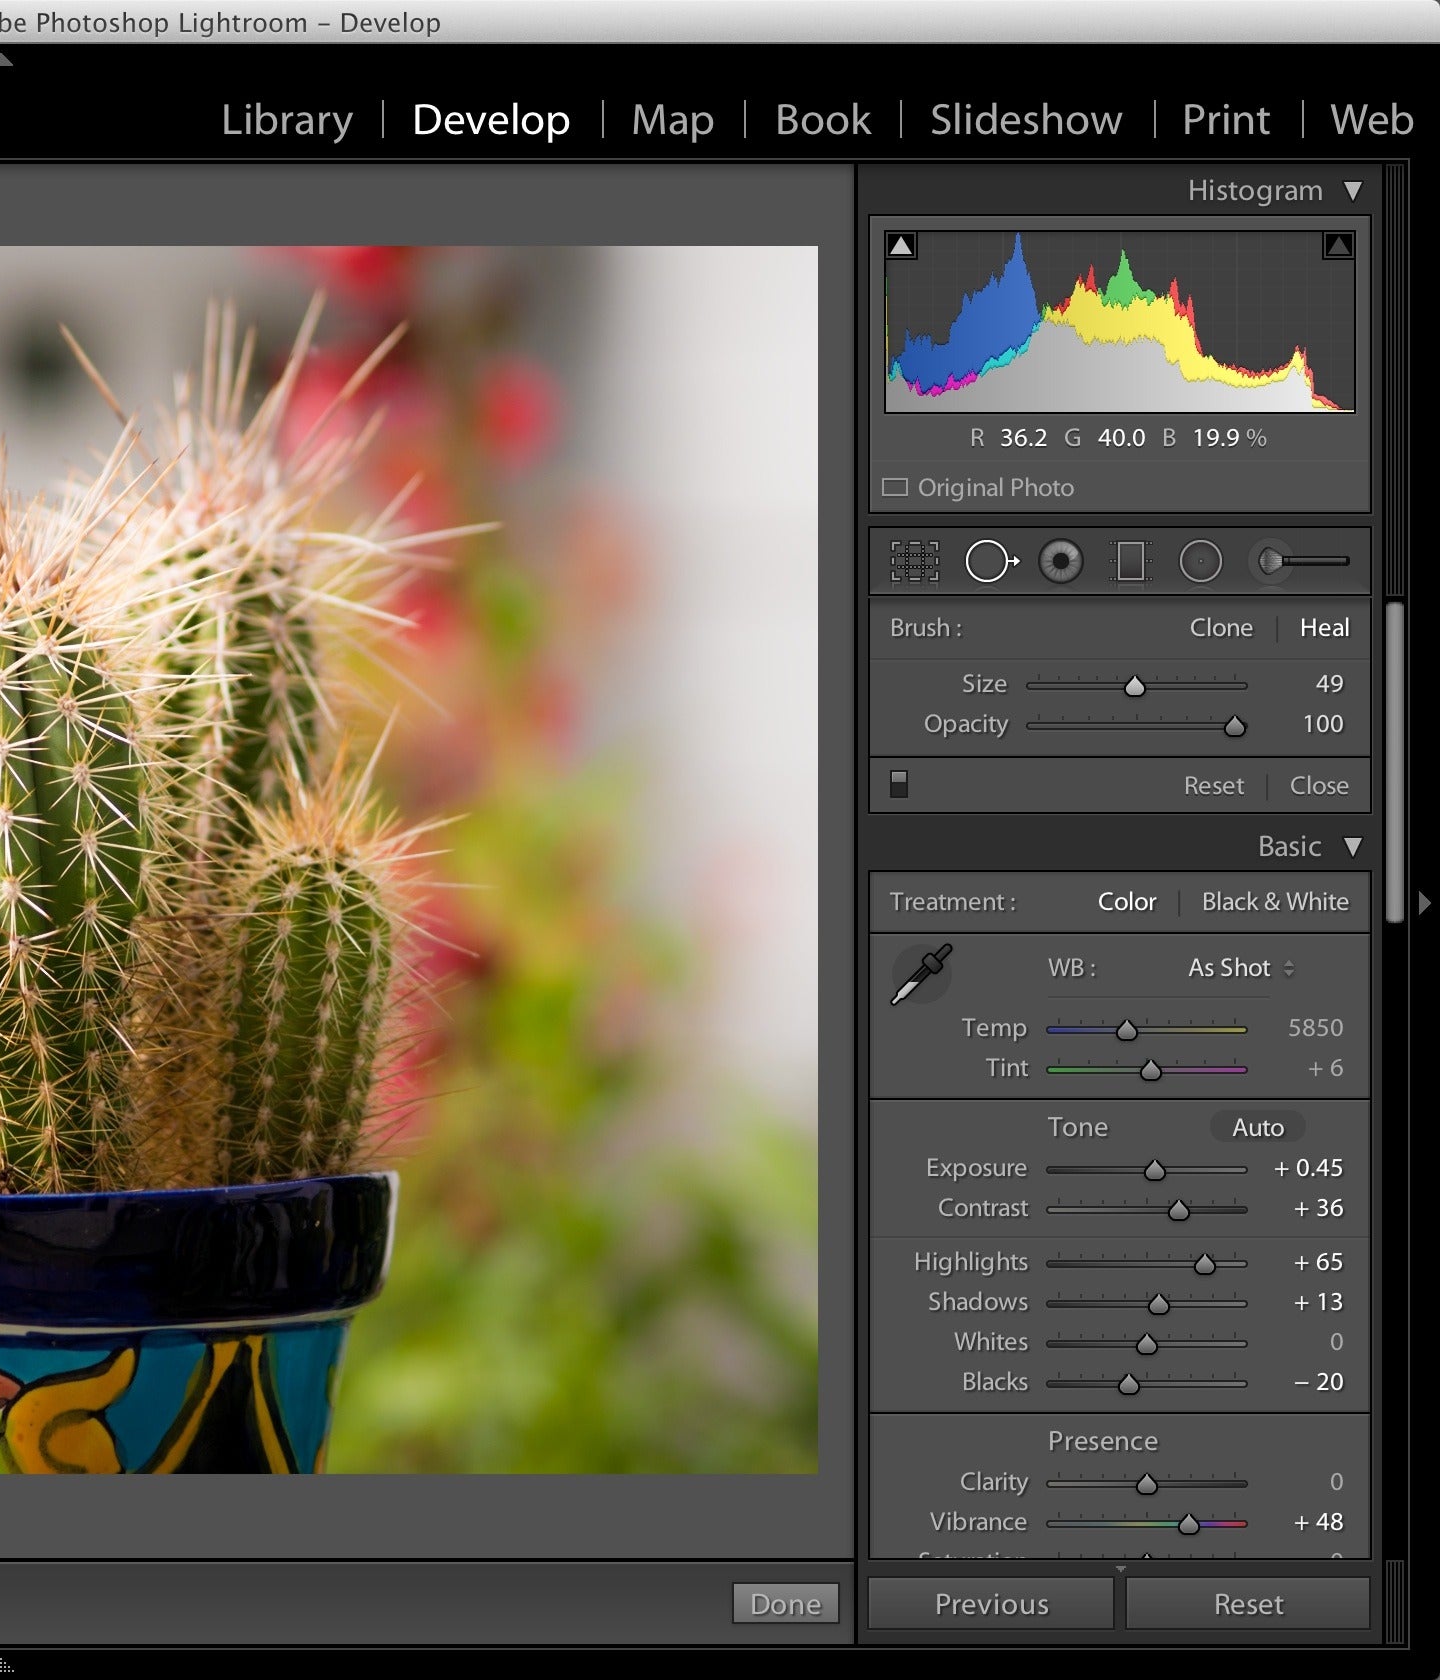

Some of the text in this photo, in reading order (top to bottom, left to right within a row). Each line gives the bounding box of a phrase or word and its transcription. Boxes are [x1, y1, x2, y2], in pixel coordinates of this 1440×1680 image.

[37, 11, 169, 38] Photoshop
[179, 11, 307, 38] Lightroom
[341, 11, 441, 38] Develop
[223, 101, 354, 145] Library
[414, 101, 570, 144] Develop
[632, 103, 714, 144] Map
[777, 101, 873, 136] Book
[931, 101, 1124, 136] Slideshow
[1184, 103, 1271, 136] Print
[1330, 101, 1414, 136] Web
[1189, 178, 1323, 207] Histogram
[971, 427, 1267, 447] R 36.2 G 40.0 B 19.9 %
[918, 476, 1075, 503] Original Photo
[1190, 616, 1254, 637] Clone
[1301, 616, 1350, 637] Heal
[962, 673, 1008, 693] Size
[1315, 674, 1344, 693] 49
[924, 713, 1009, 739] Opacity
[1304, 714, 1344, 733] 100
[1185, 775, 1245, 795] Reset
[1290, 774, 1350, 795] Close
[1259, 834, 1322, 857] Basic
[1098, 890, 1158, 911] Color
[1203, 890, 1350, 911] Black & White
[1188, 956, 1271, 977] As Shot
[961, 1017, 1027, 1042] Temp
[1288, 1018, 1344, 1037] 5850
[985, 1057, 1029, 1077] Tint
[1330, 1058, 1344, 1077] 6
[1047, 1116, 1109, 1137] Tone
[1232, 1117, 1285, 1137] Auto
[927, 1157, 1027, 1182] Exposure
[1296, 1158, 1343, 1177] 0.45
[938, 1197, 1029, 1217] Contrast
[1316, 1198, 1344, 1217] 36
[915, 1250, 1028, 1276] Highlights
[1316, 1252, 1343, 1271] 65
[928, 1290, 1028, 1311] Shadows
[1318, 1292, 1343, 1311] 13
[953, 1330, 1028, 1351] Whites
[1330, 1332, 1344, 1351] 0
[963, 1370, 1028, 1391] Blacks
[1316, 1372, 1344, 1391] 20
[1049, 1430, 1159, 1451] Presence
[960, 1470, 1029, 1497] Clarity
[1330, 1472, 1344, 1491] 0
[929, 1510, 1027, 1531] Vibrance
[1315, 1512, 1344, 1531] 48
[751, 1592, 821, 1615] Done
[936, 1592, 1049, 1615] Previous
[1215, 1592, 1285, 1615] Reset
